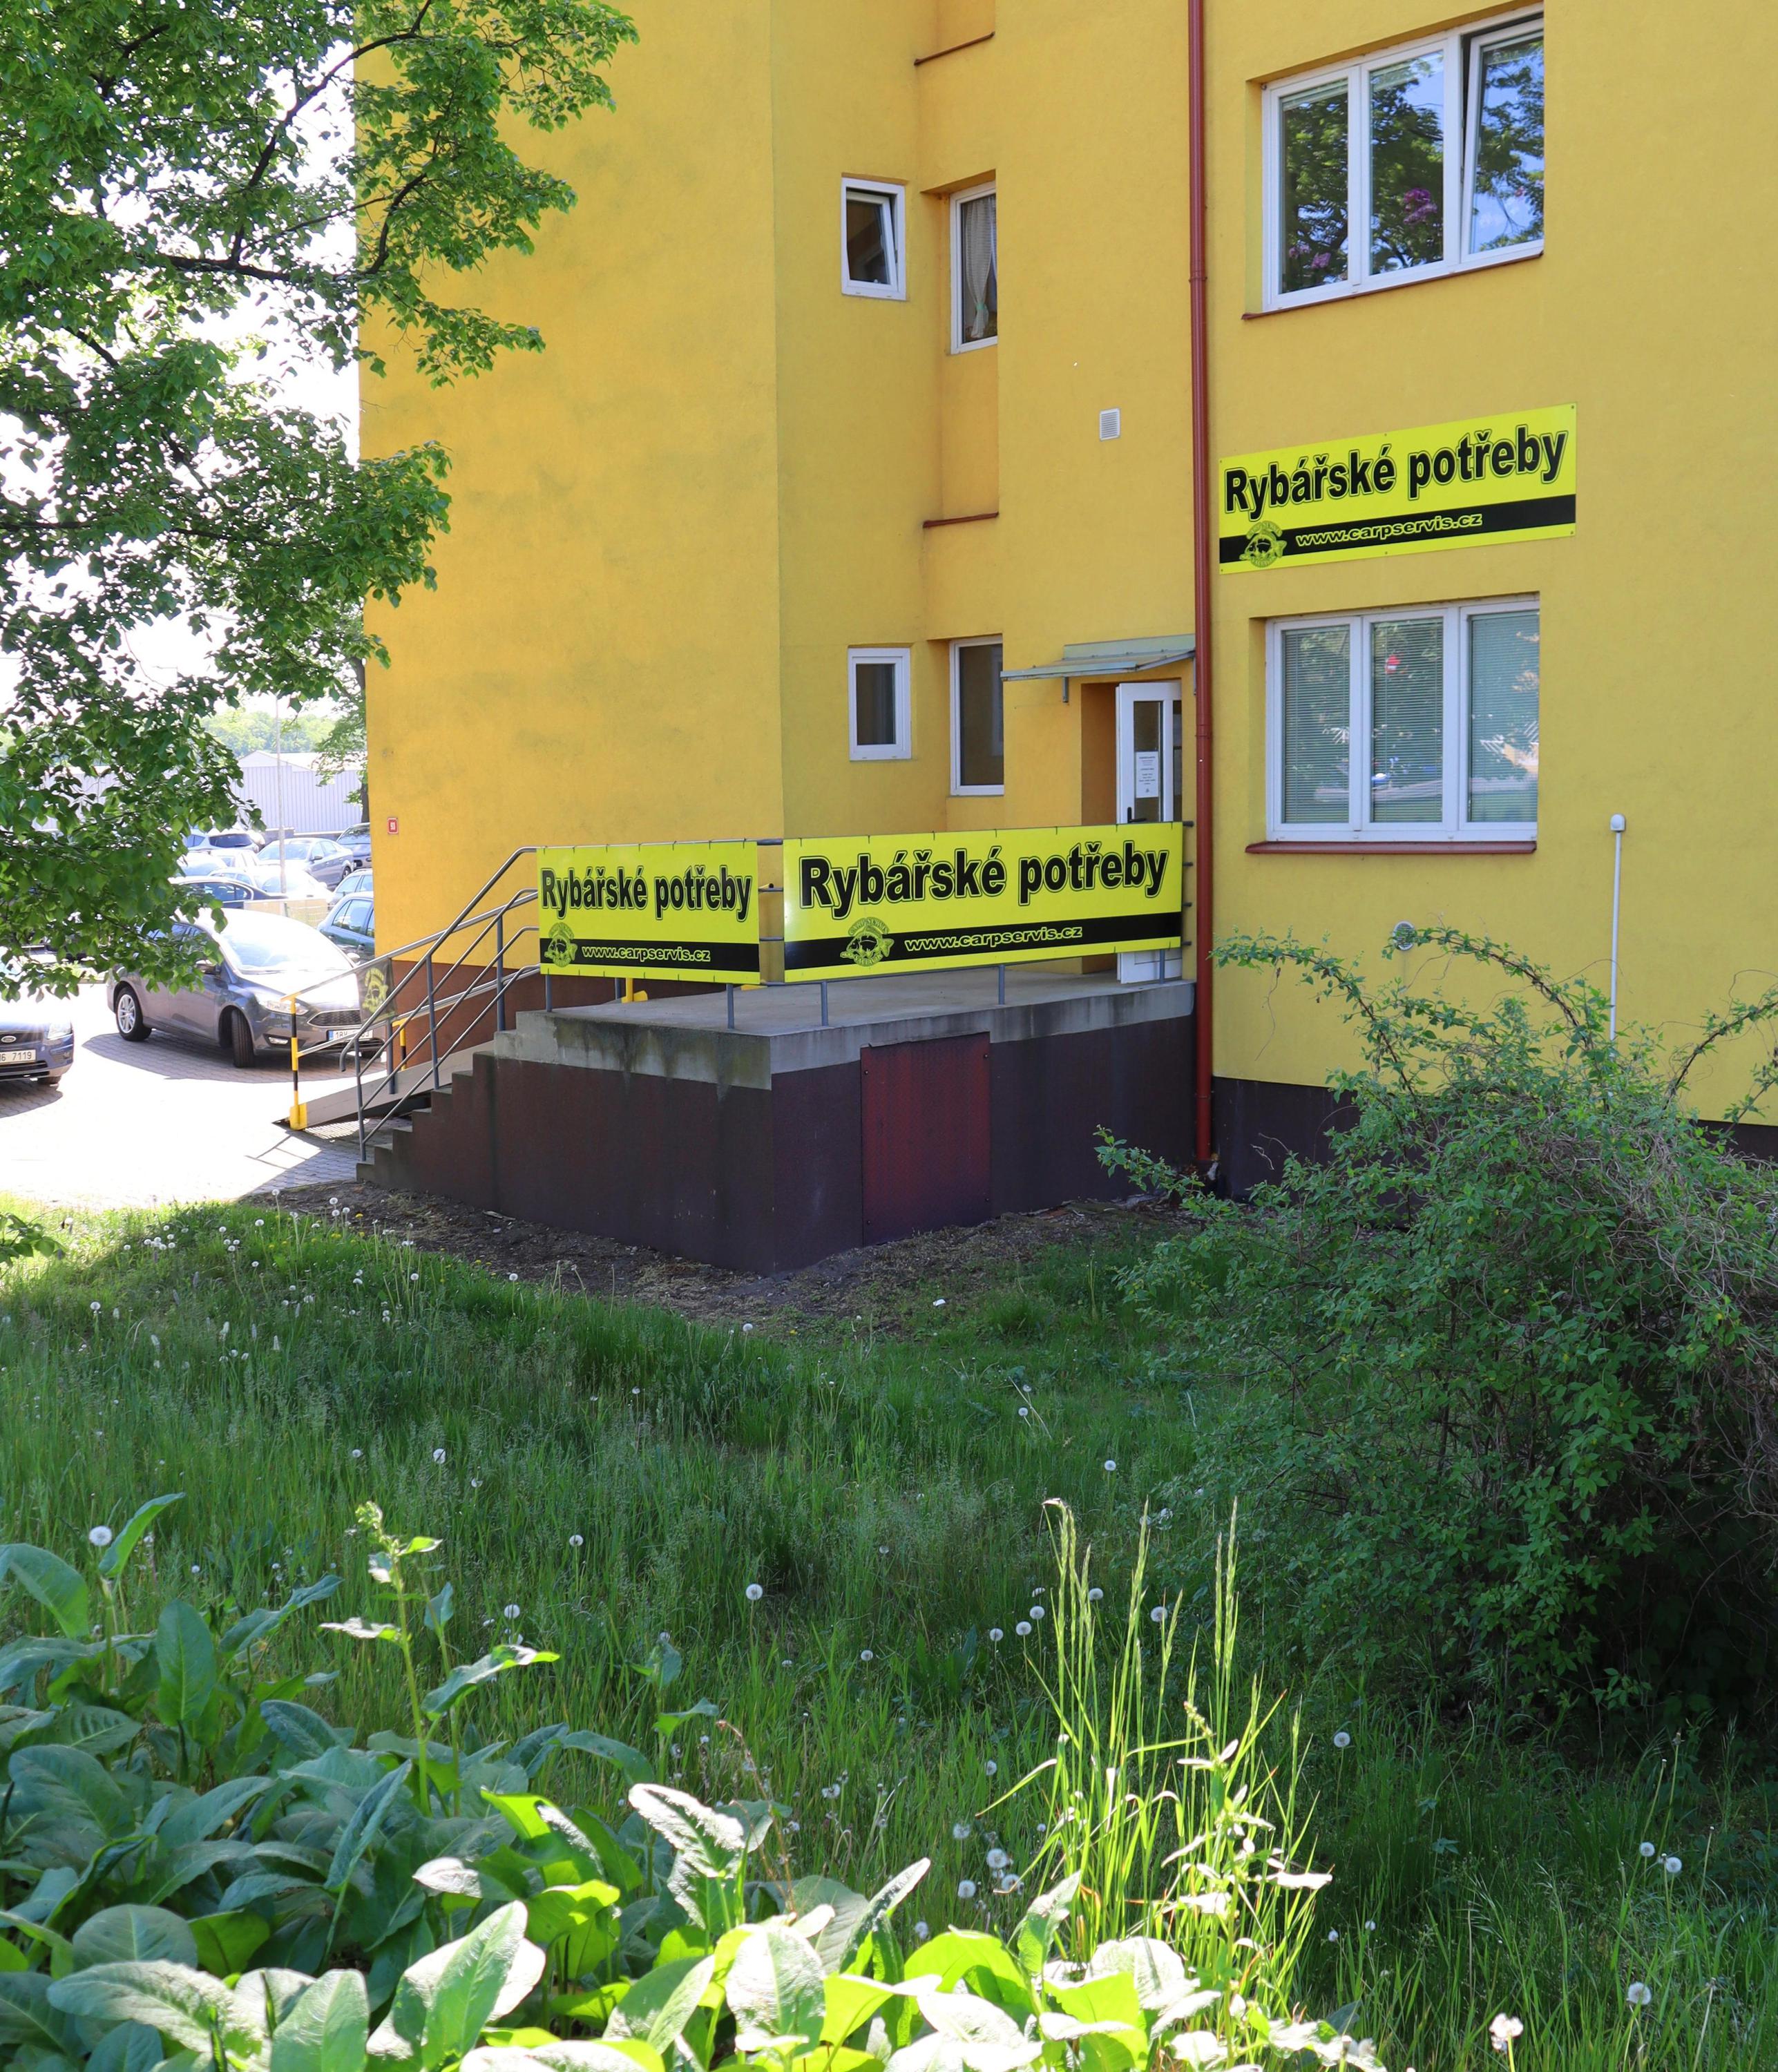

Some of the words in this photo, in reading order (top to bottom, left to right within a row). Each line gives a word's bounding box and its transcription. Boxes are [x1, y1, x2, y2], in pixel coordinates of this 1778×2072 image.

[1225, 443, 1396, 521] Rybářské
[1408, 423, 1568, 501] potřeby
[1296, 514, 1482, 546] www.carpservis.cz
[541, 866, 648, 919] Rybářské
[654, 865, 752, 923] potřeby
[799, 845, 1006, 920] Rybářské
[1018, 840, 1169, 906] potřeby
[582, 946, 710, 962] www.carpservis.cz
[905, 927, 1082, 952] www.carpservis.cz
[12, 1051, 32, 1061] 7119
